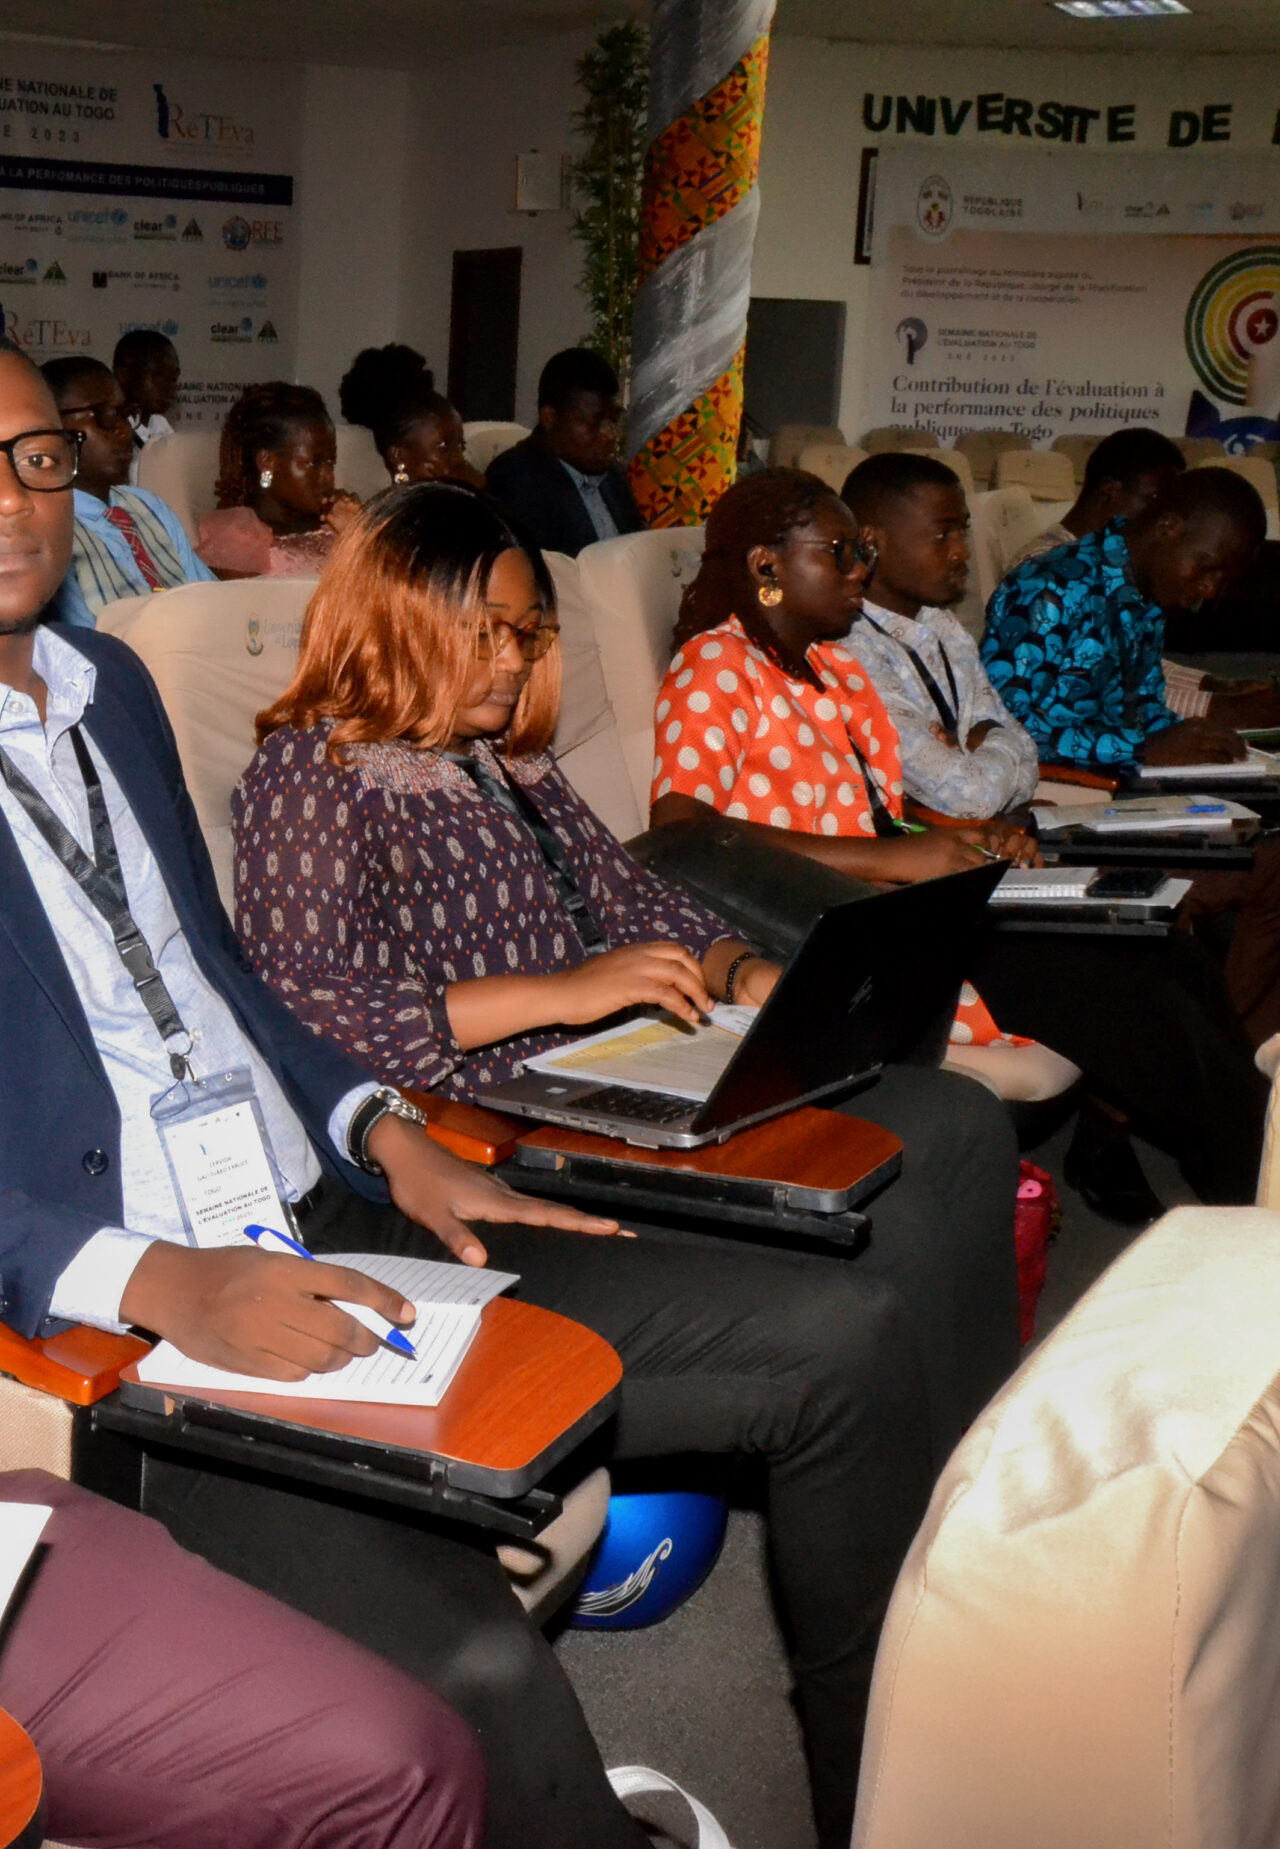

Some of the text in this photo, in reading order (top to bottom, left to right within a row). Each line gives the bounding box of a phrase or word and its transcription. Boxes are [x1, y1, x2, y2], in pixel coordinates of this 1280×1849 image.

[16, 79, 96, 100] NATIONALE
[98, 87, 118, 103] DE
[52, 103, 71, 117] AU
[75, 105, 115, 120] TOGO
[862, 92, 1137, 145] UNIVERSITE
[1167, 103, 1233, 148] DE
[8, 167, 24, 179] LA
[108, 173, 131, 186] DES
[133, 218, 163, 232] clear
[210, 321, 240, 335] clear
[892, 375, 1166, 399] Contribution de l'évaluation à
[890, 396, 1161, 423] la performance des politiques
[1009, 421, 1054, 442] Togo
[195, 1202, 223, 1217] SEMAINE
[260, 1185, 269, 1193] DE
[244, 1201, 253, 1209] AU
[253, 1194, 271, 1206] TOGO
